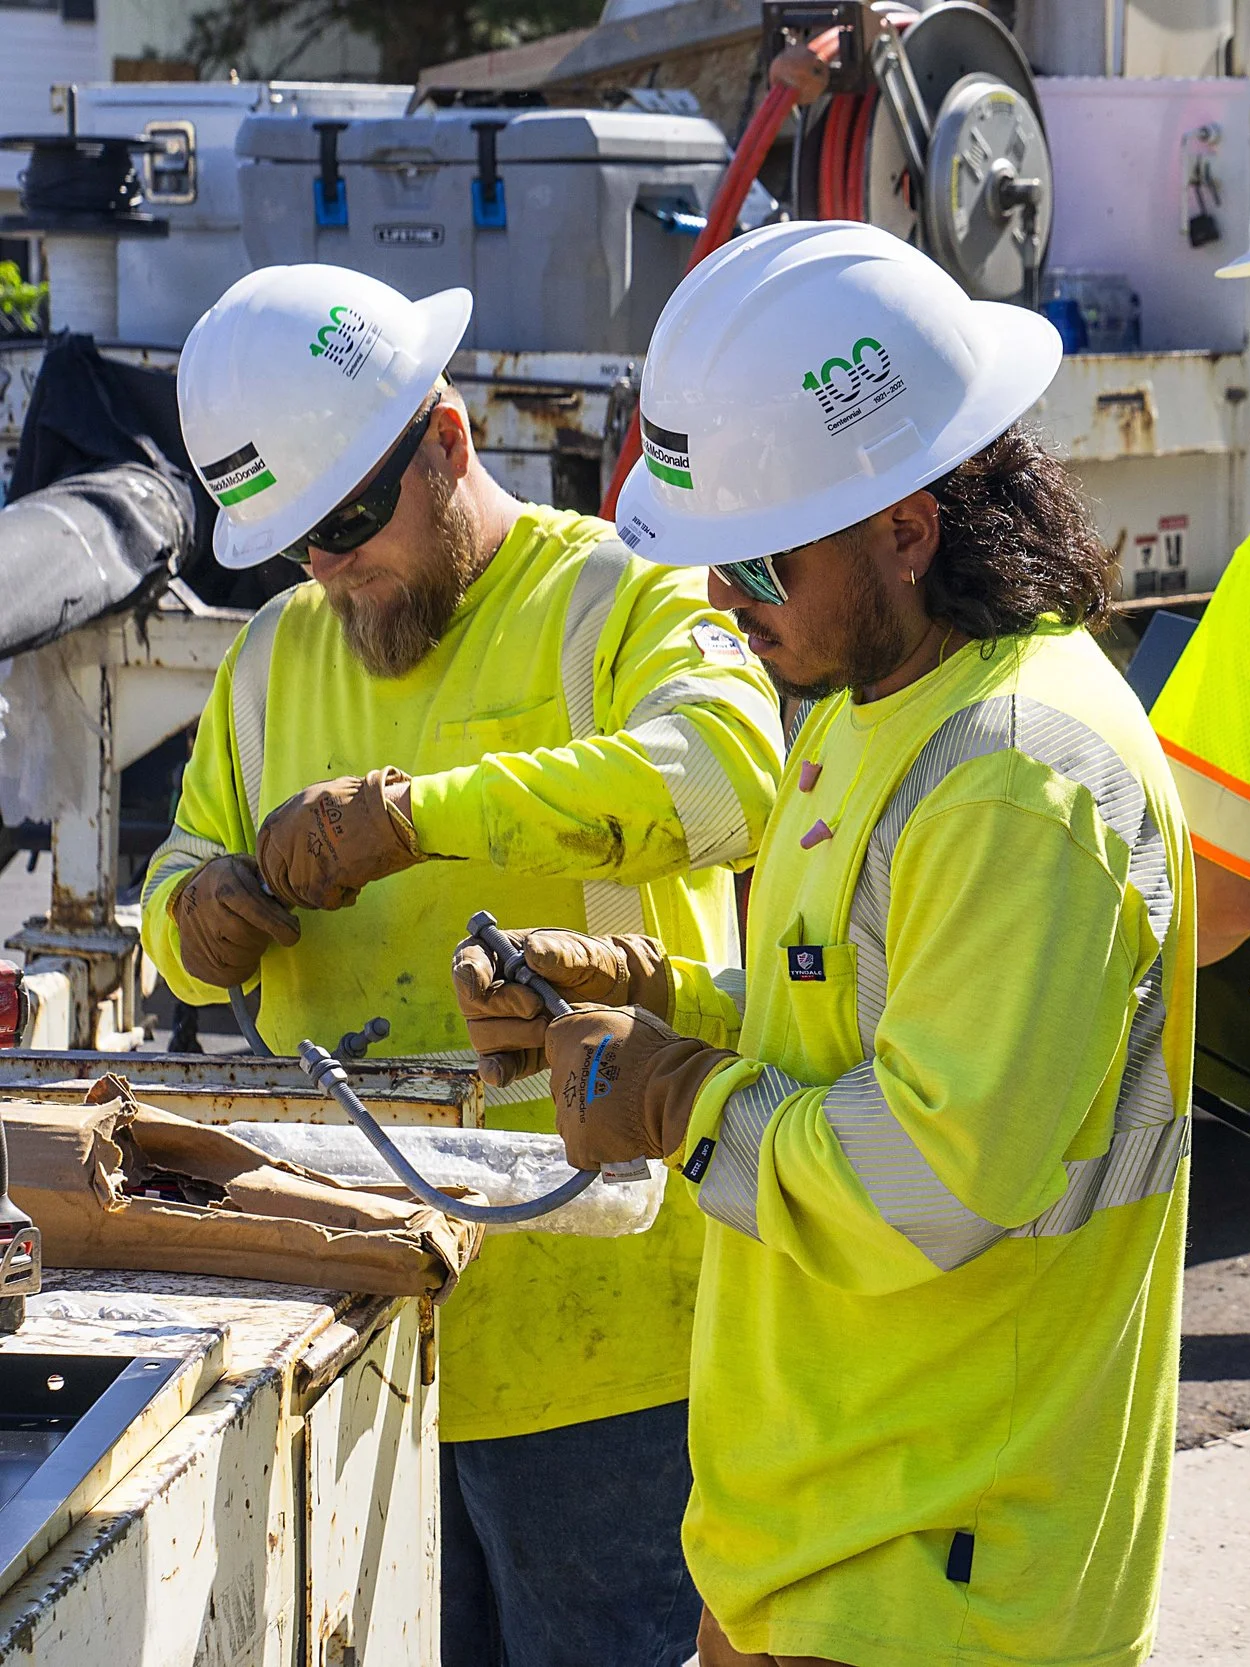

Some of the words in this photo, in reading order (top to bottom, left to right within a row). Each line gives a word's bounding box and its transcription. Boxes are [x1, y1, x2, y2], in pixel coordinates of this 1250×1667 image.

[309, 305, 365, 367] 100
[802, 337, 891, 414] 100
[826, 407, 863, 432] Centennial
[701, 1143, 710, 1157] CAT
[690, 1162, 702, 1176] 2112
